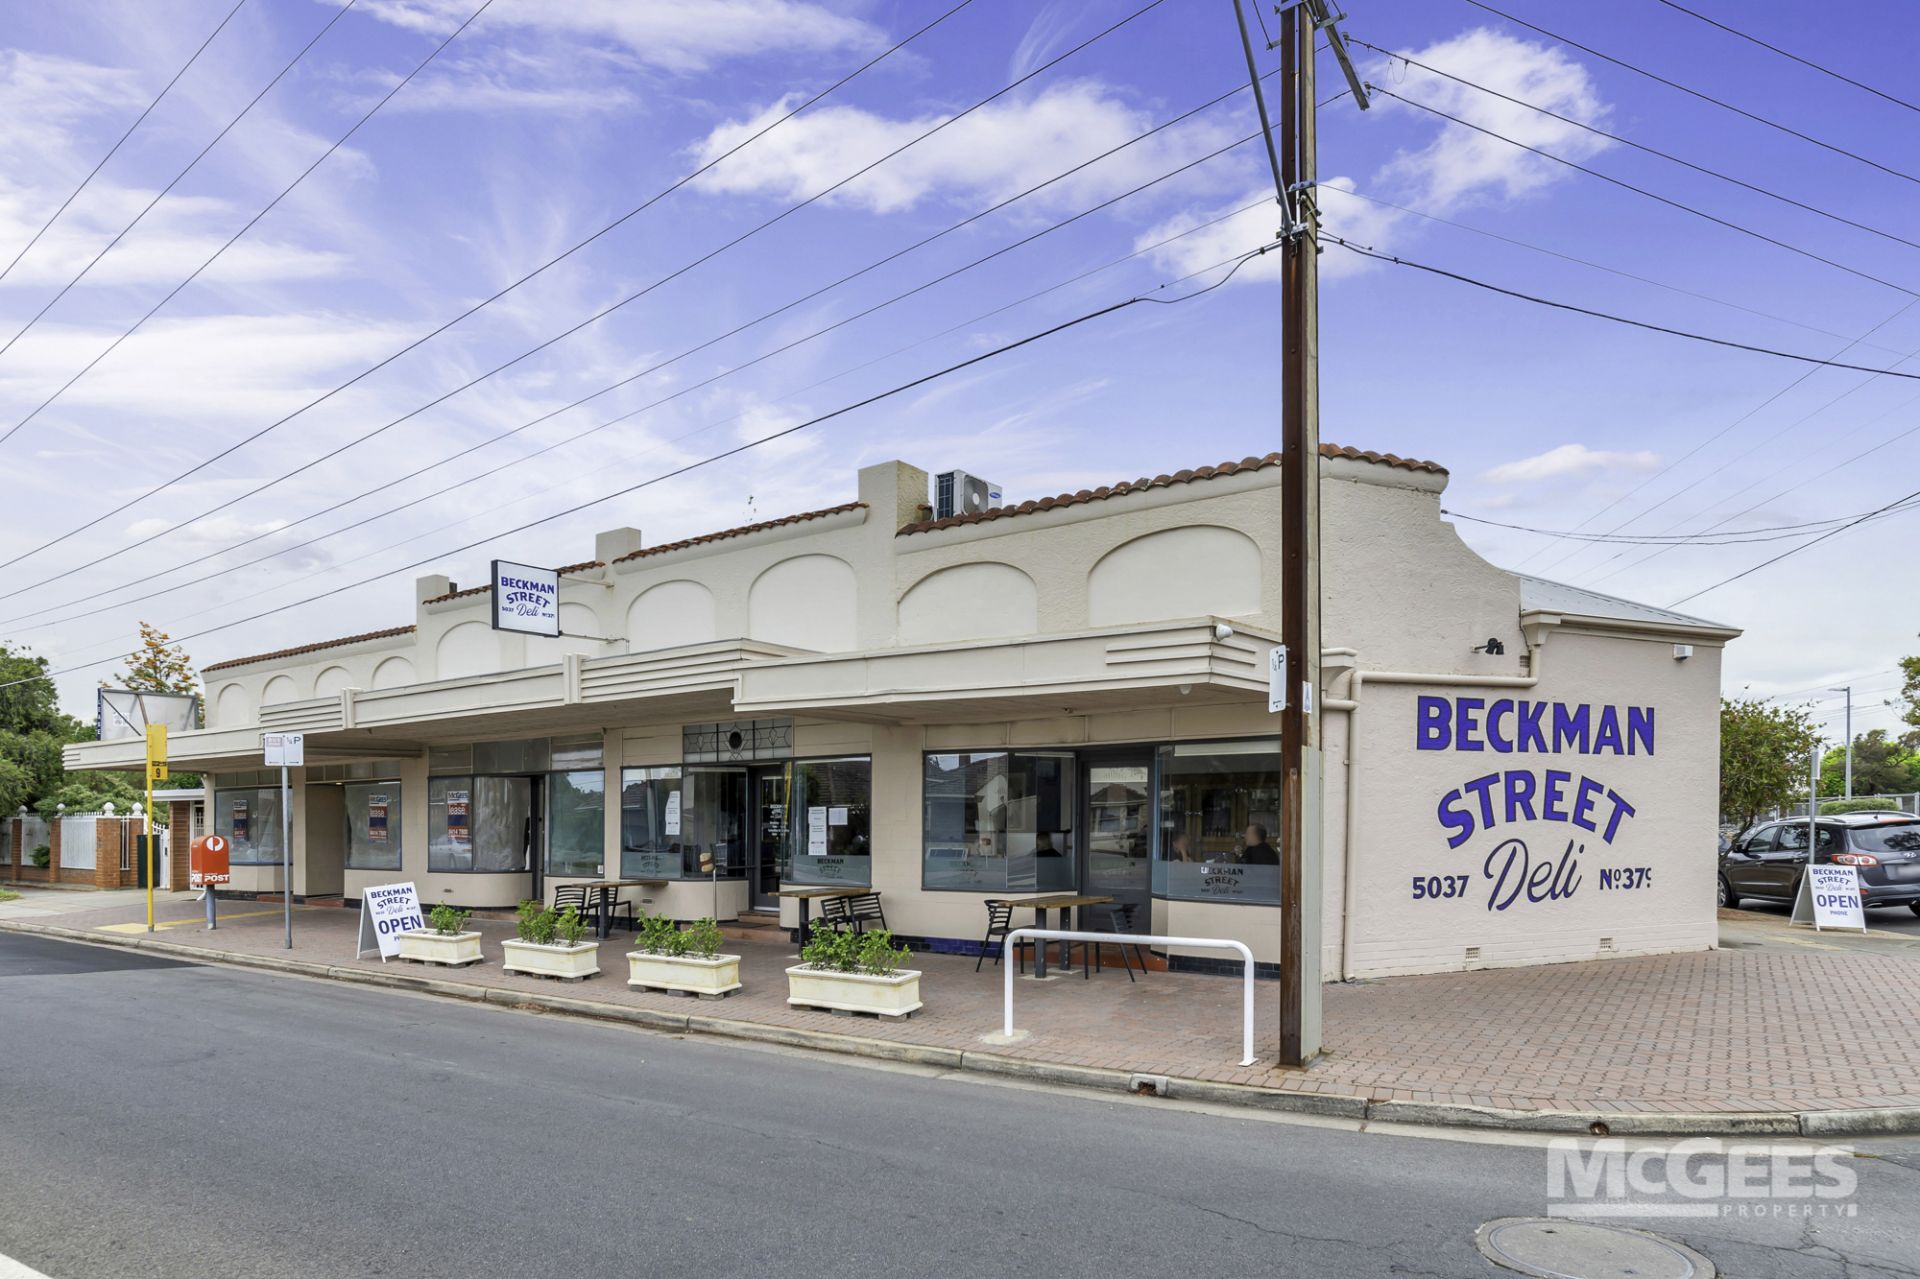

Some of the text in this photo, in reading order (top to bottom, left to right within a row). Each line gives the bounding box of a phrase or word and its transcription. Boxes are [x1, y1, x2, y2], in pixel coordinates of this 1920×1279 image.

[501, 576, 554, 594] BECKMAN
[506, 591, 550, 608] STREET
[516, 603, 540, 616] Deli
[1416, 695, 1655, 756] BECKMAN
[1437, 769, 1636, 850] STREET
[204, 874, 230, 882] POST
[1205, 876, 1239, 887] STREET
[1412, 875, 1470, 899] 5037
[1484, 838, 1585, 912] Deli
[1817, 876, 1852, 885] STREET
[371, 887, 413, 898] BECKMAN
[377, 897, 411, 909] STREET
[1816, 894, 1859, 908] OPEN
[378, 915, 422, 934] OPEN
